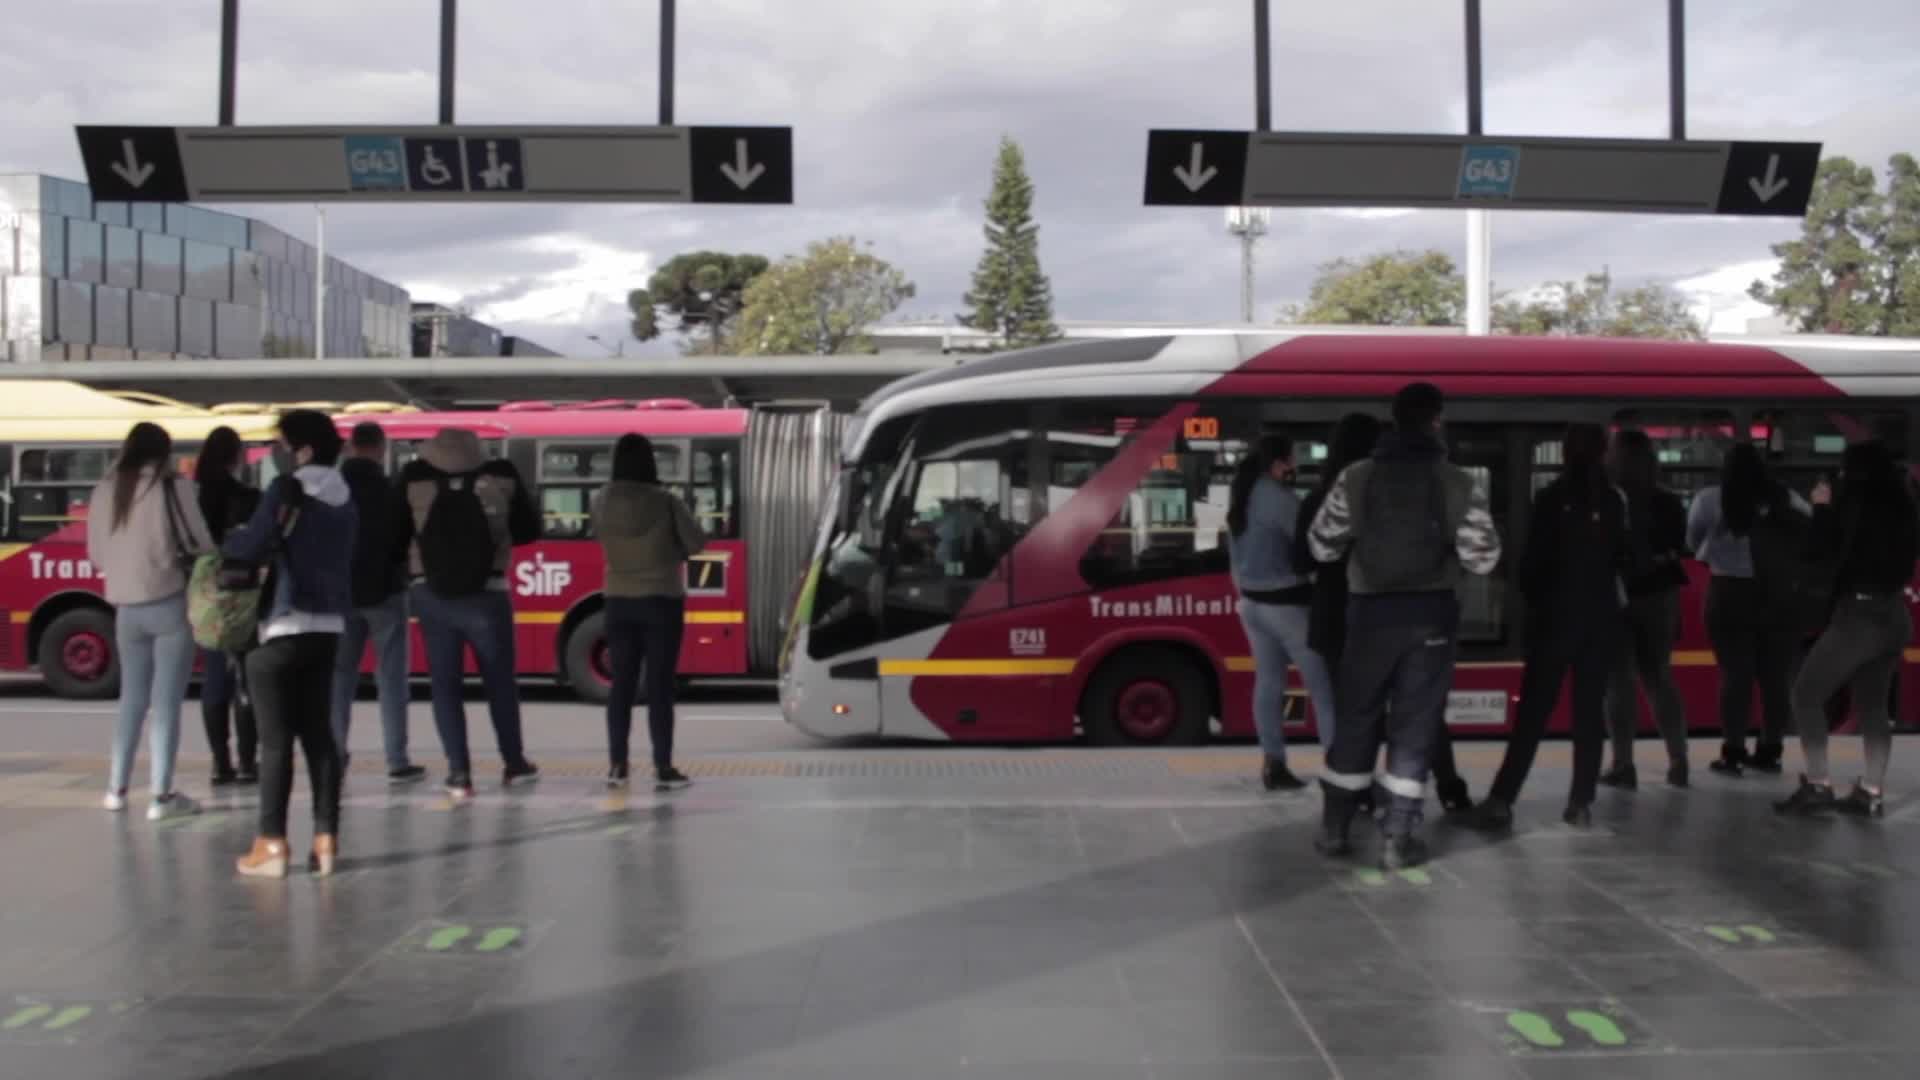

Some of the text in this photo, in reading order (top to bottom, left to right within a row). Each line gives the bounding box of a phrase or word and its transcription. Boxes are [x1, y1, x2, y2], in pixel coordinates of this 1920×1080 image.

[351, 150, 399, 174] G43
[1465, 159, 1512, 182] G43
[29, 552, 105, 579] Tran
